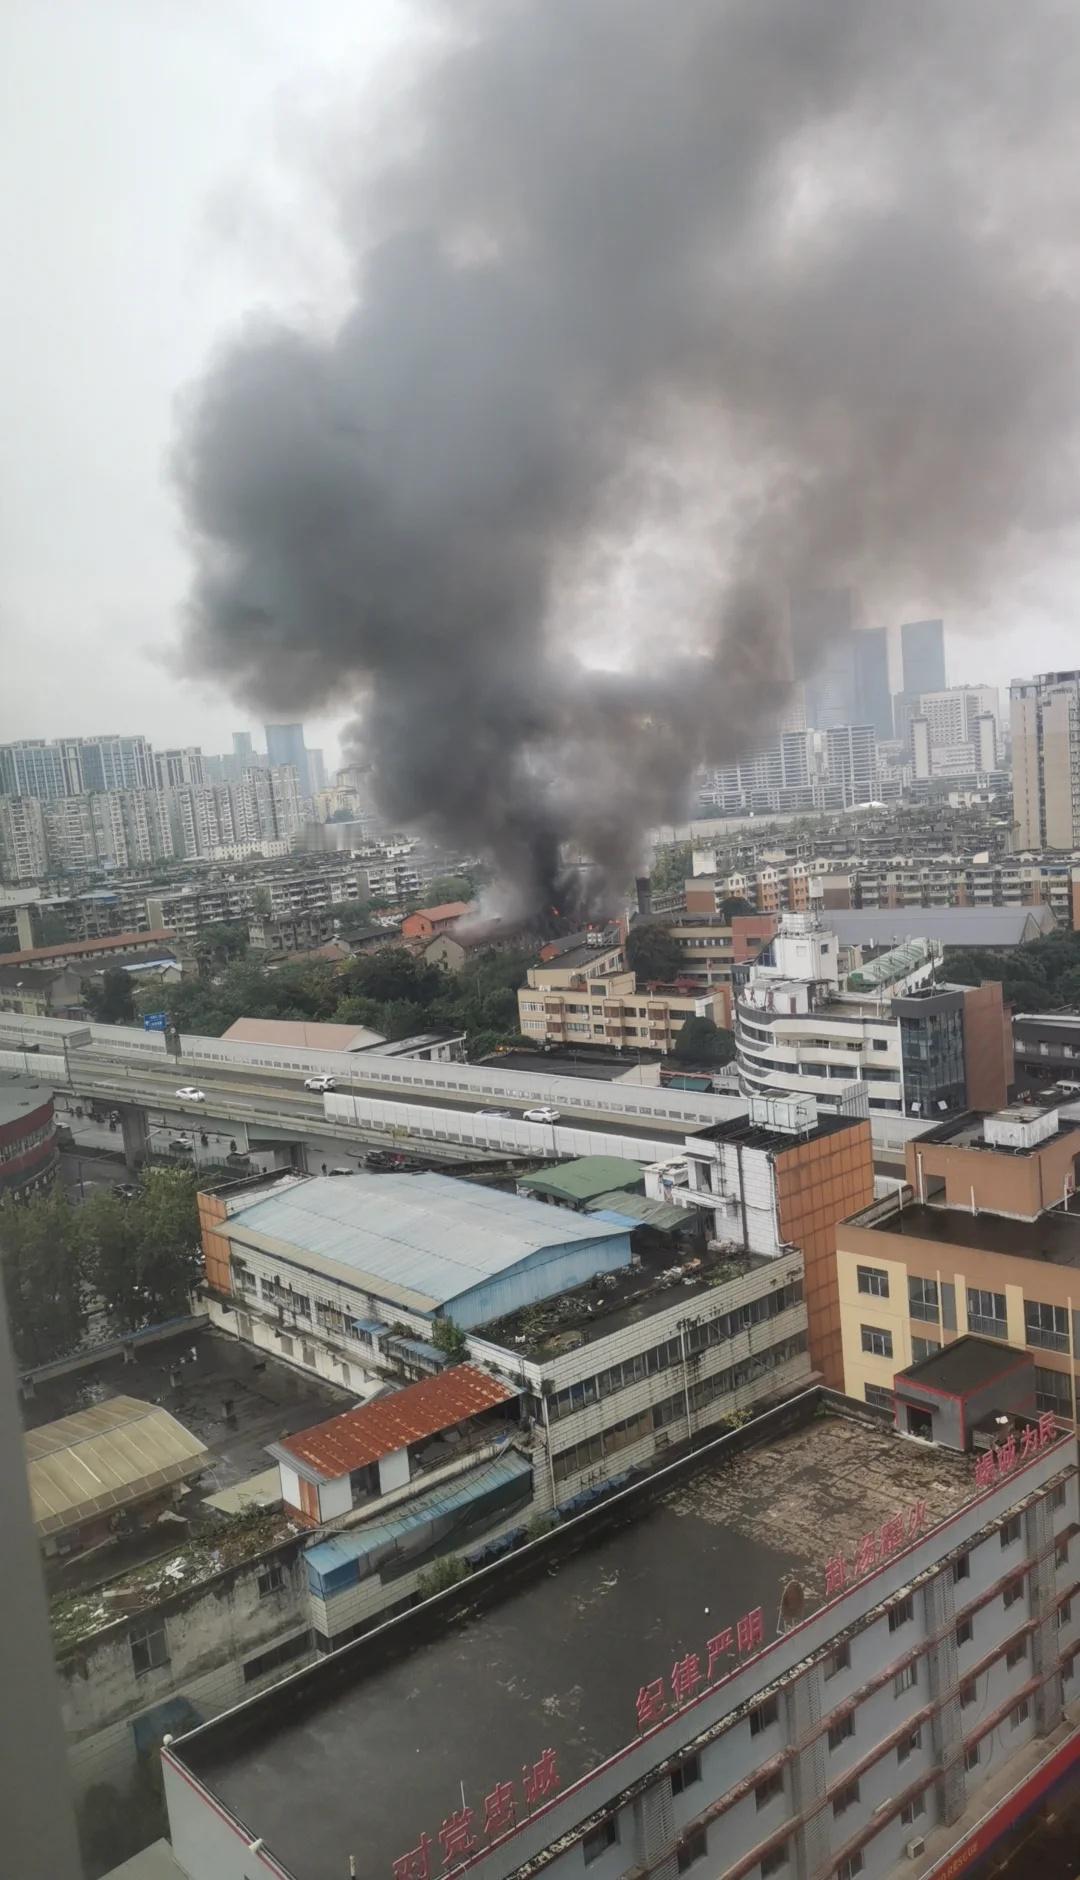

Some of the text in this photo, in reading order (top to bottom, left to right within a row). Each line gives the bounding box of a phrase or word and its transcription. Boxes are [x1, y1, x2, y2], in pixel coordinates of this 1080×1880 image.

[393, 1410, 1057, 1880] 对党忠诚 纪律严明 赴汤蹈火 竭诚为民
